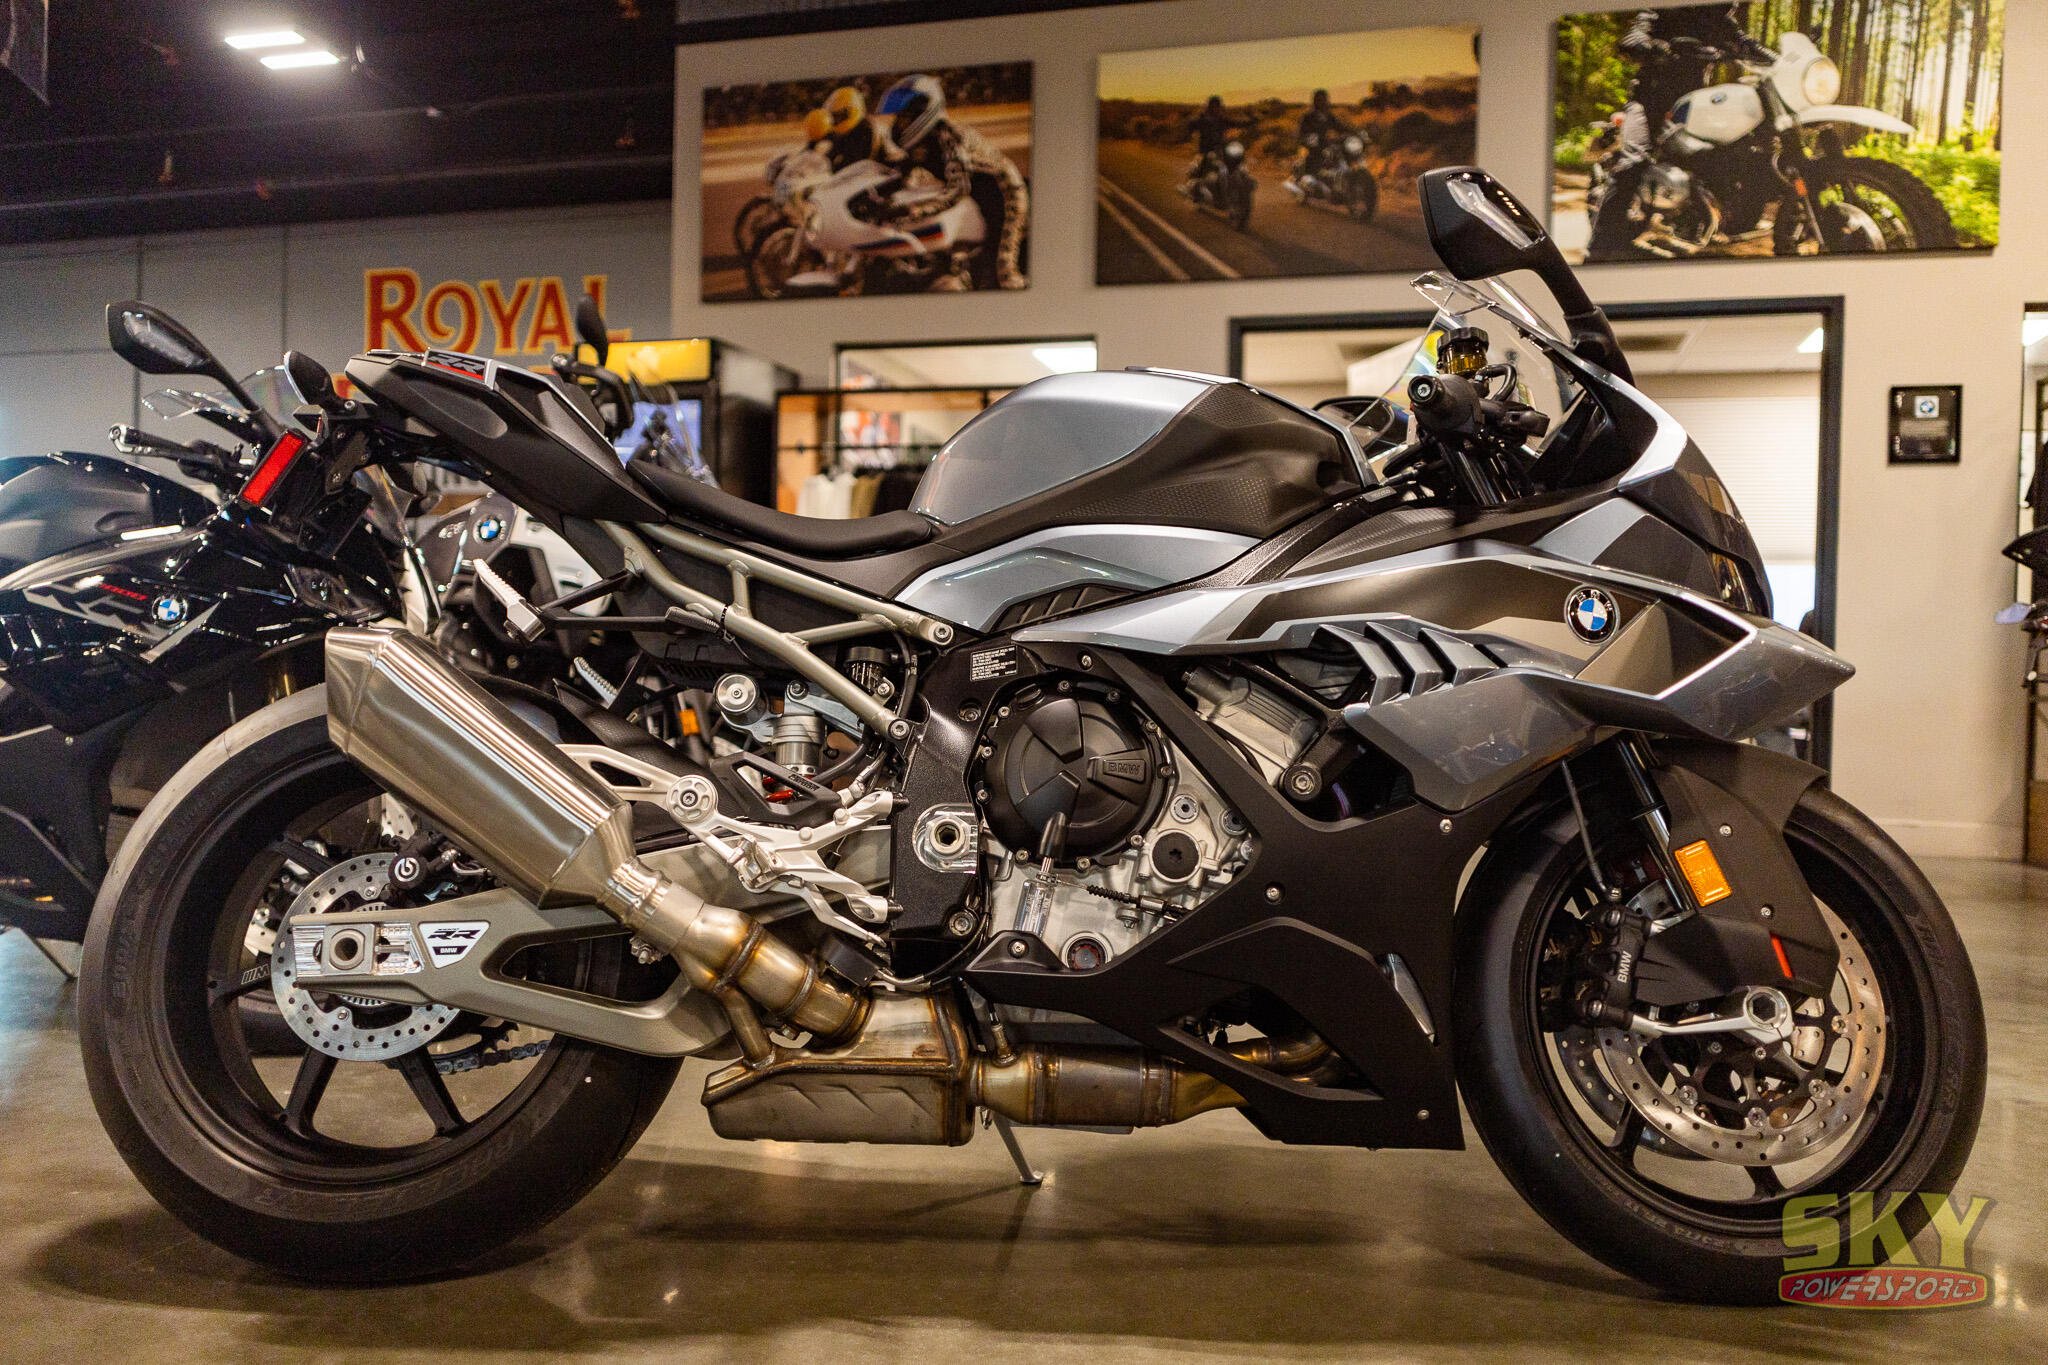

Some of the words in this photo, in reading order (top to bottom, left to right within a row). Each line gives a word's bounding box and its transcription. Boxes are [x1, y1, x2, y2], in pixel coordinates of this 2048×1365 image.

[1108, 762, 1141, 776] BMW
[427, 929, 481, 940] RR
[1617, 950, 1633, 983] BMW
